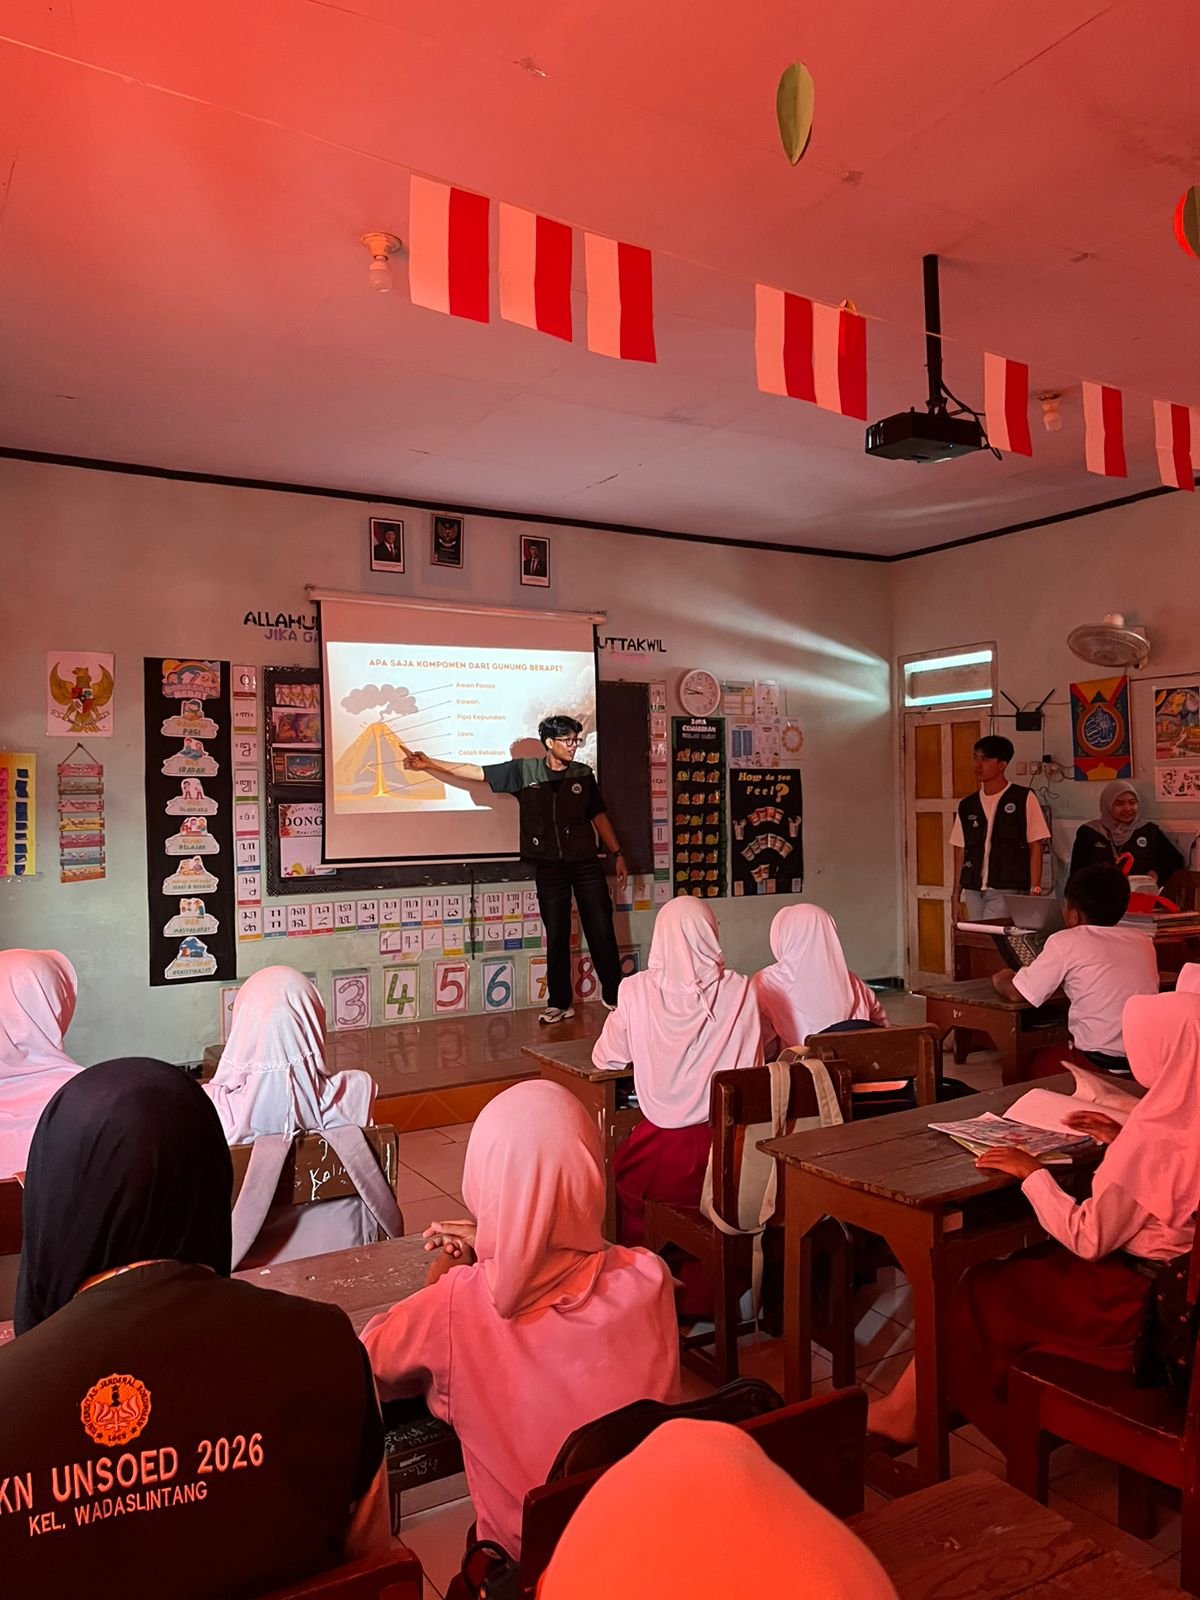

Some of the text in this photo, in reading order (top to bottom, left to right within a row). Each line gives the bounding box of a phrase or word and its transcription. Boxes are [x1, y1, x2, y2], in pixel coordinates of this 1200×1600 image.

[264, 628, 298, 641] JIKA
[369, 659, 563, 672] APA SAJA KOMPONEN DARI GUNUNG BERAPI?
[738, 772, 762, 782] How
[338, 979, 366, 1026] 3
[386, 973, 415, 1015] 4
[436, 966, 466, 1007] 5
[486, 965, 511, 1007] 6
[575, 956, 597, 998] 8
[51, 1446, 179, 1503] UNSOED
[197, 1432, 264, 1475] 2026
[28, 1481, 208, 1537] KEL. WADASLINTANG
